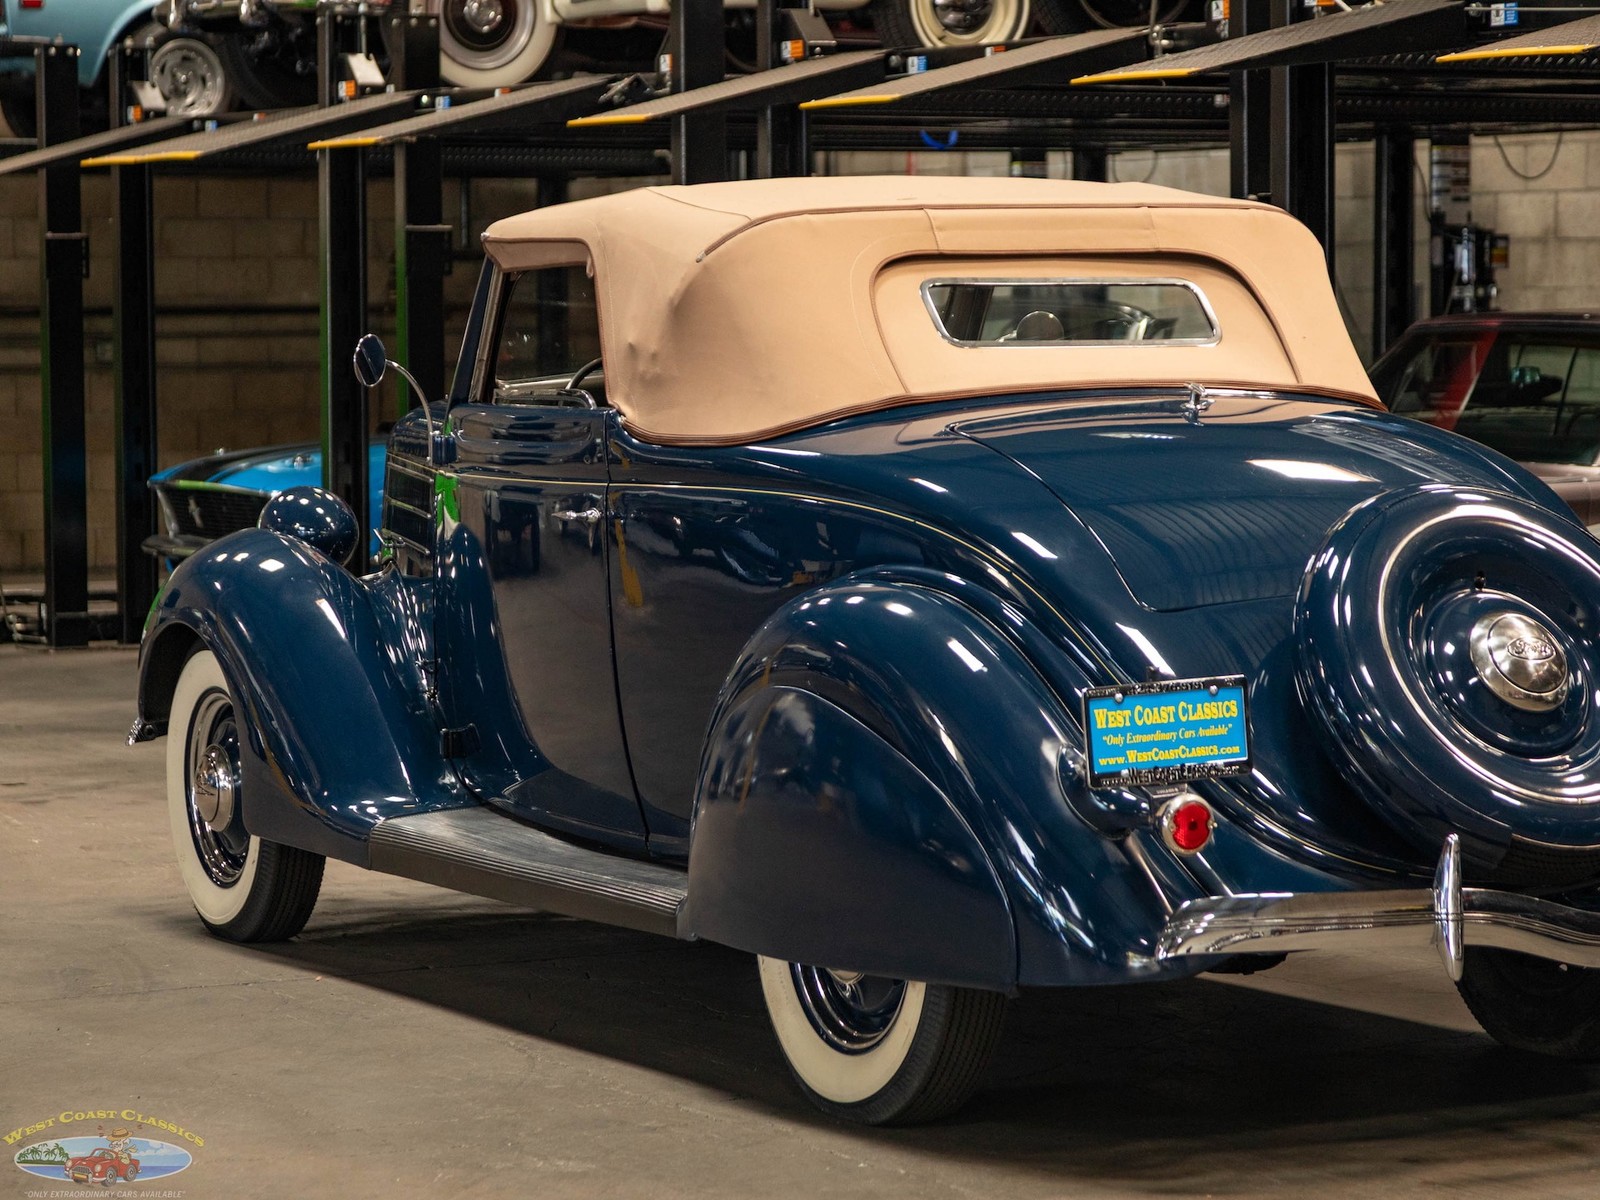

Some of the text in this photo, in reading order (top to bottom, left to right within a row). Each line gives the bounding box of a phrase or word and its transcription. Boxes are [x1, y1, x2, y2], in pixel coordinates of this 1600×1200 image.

[1094, 699, 1239, 729] WEST COAST CLASSICS
[1126, 730, 1178, 746] Extraordinary
[1179, 727, 1196, 740] Cars
